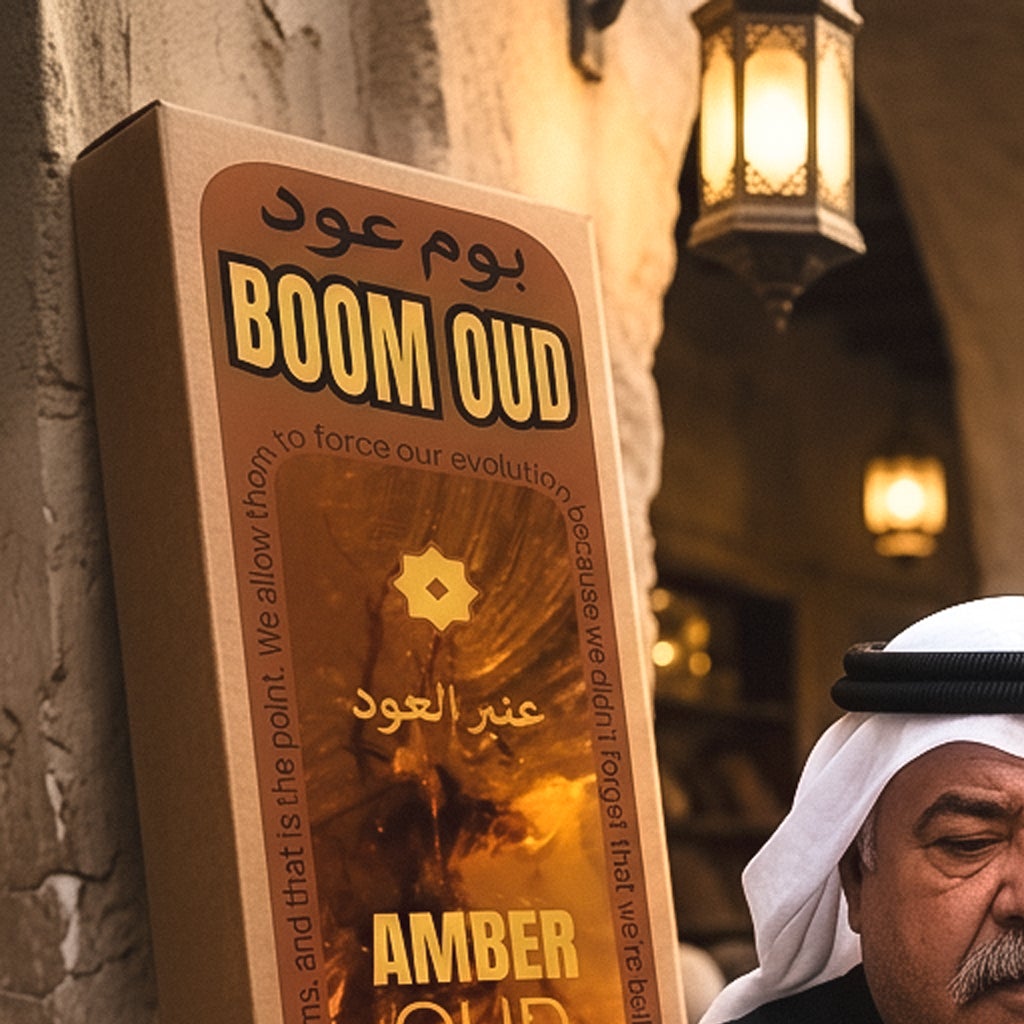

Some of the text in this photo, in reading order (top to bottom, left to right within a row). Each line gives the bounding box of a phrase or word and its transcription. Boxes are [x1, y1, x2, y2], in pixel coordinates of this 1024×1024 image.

[261, 186, 525, 292] بوم عود
[218, 250, 578, 430] BOOM OUD
[272, 429, 306, 452] to
[313, 423, 390, 460] force
[397, 443, 443, 466] our
[451, 451, 571, 503] evolution
[248, 527, 278, 606] allow
[257, 610, 282, 657] We
[586, 625, 606, 664] we
[353, 681, 545, 740] عنبر العود
[272, 758, 299, 809] the
[276, 813, 301, 839] is
[281, 847, 306, 905] that
[287, 914, 316, 972] and
[373, 908, 580, 987] AMBER
